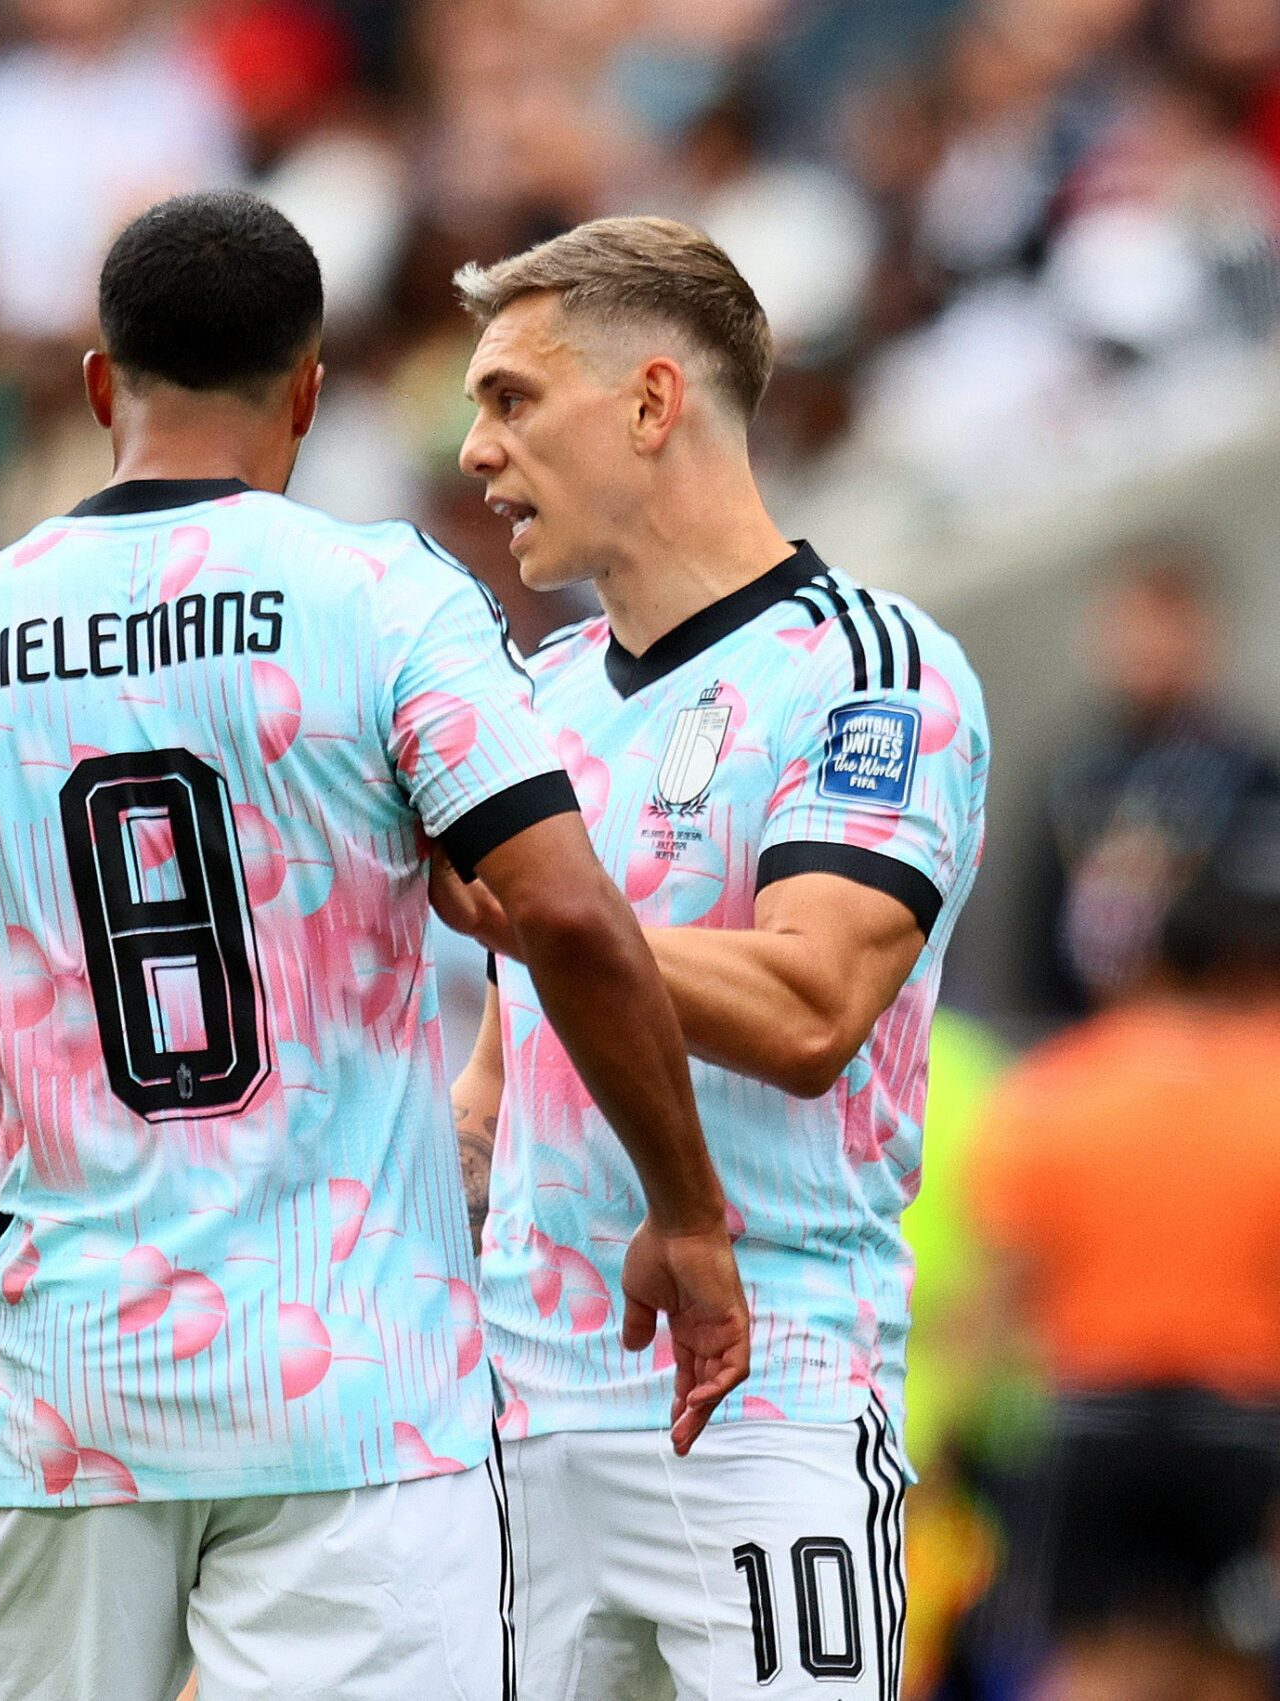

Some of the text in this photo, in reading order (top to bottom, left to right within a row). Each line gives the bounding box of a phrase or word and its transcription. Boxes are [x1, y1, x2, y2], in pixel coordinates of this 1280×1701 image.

[842, 714, 903, 737] FOOTBALL
[842, 732, 903, 760] UNITES
[832, 753, 903, 782] the World
[849, 774, 876, 790] FIFA
[59, 748, 272, 1124] 8
[732, 1537, 865, 1686] 10
